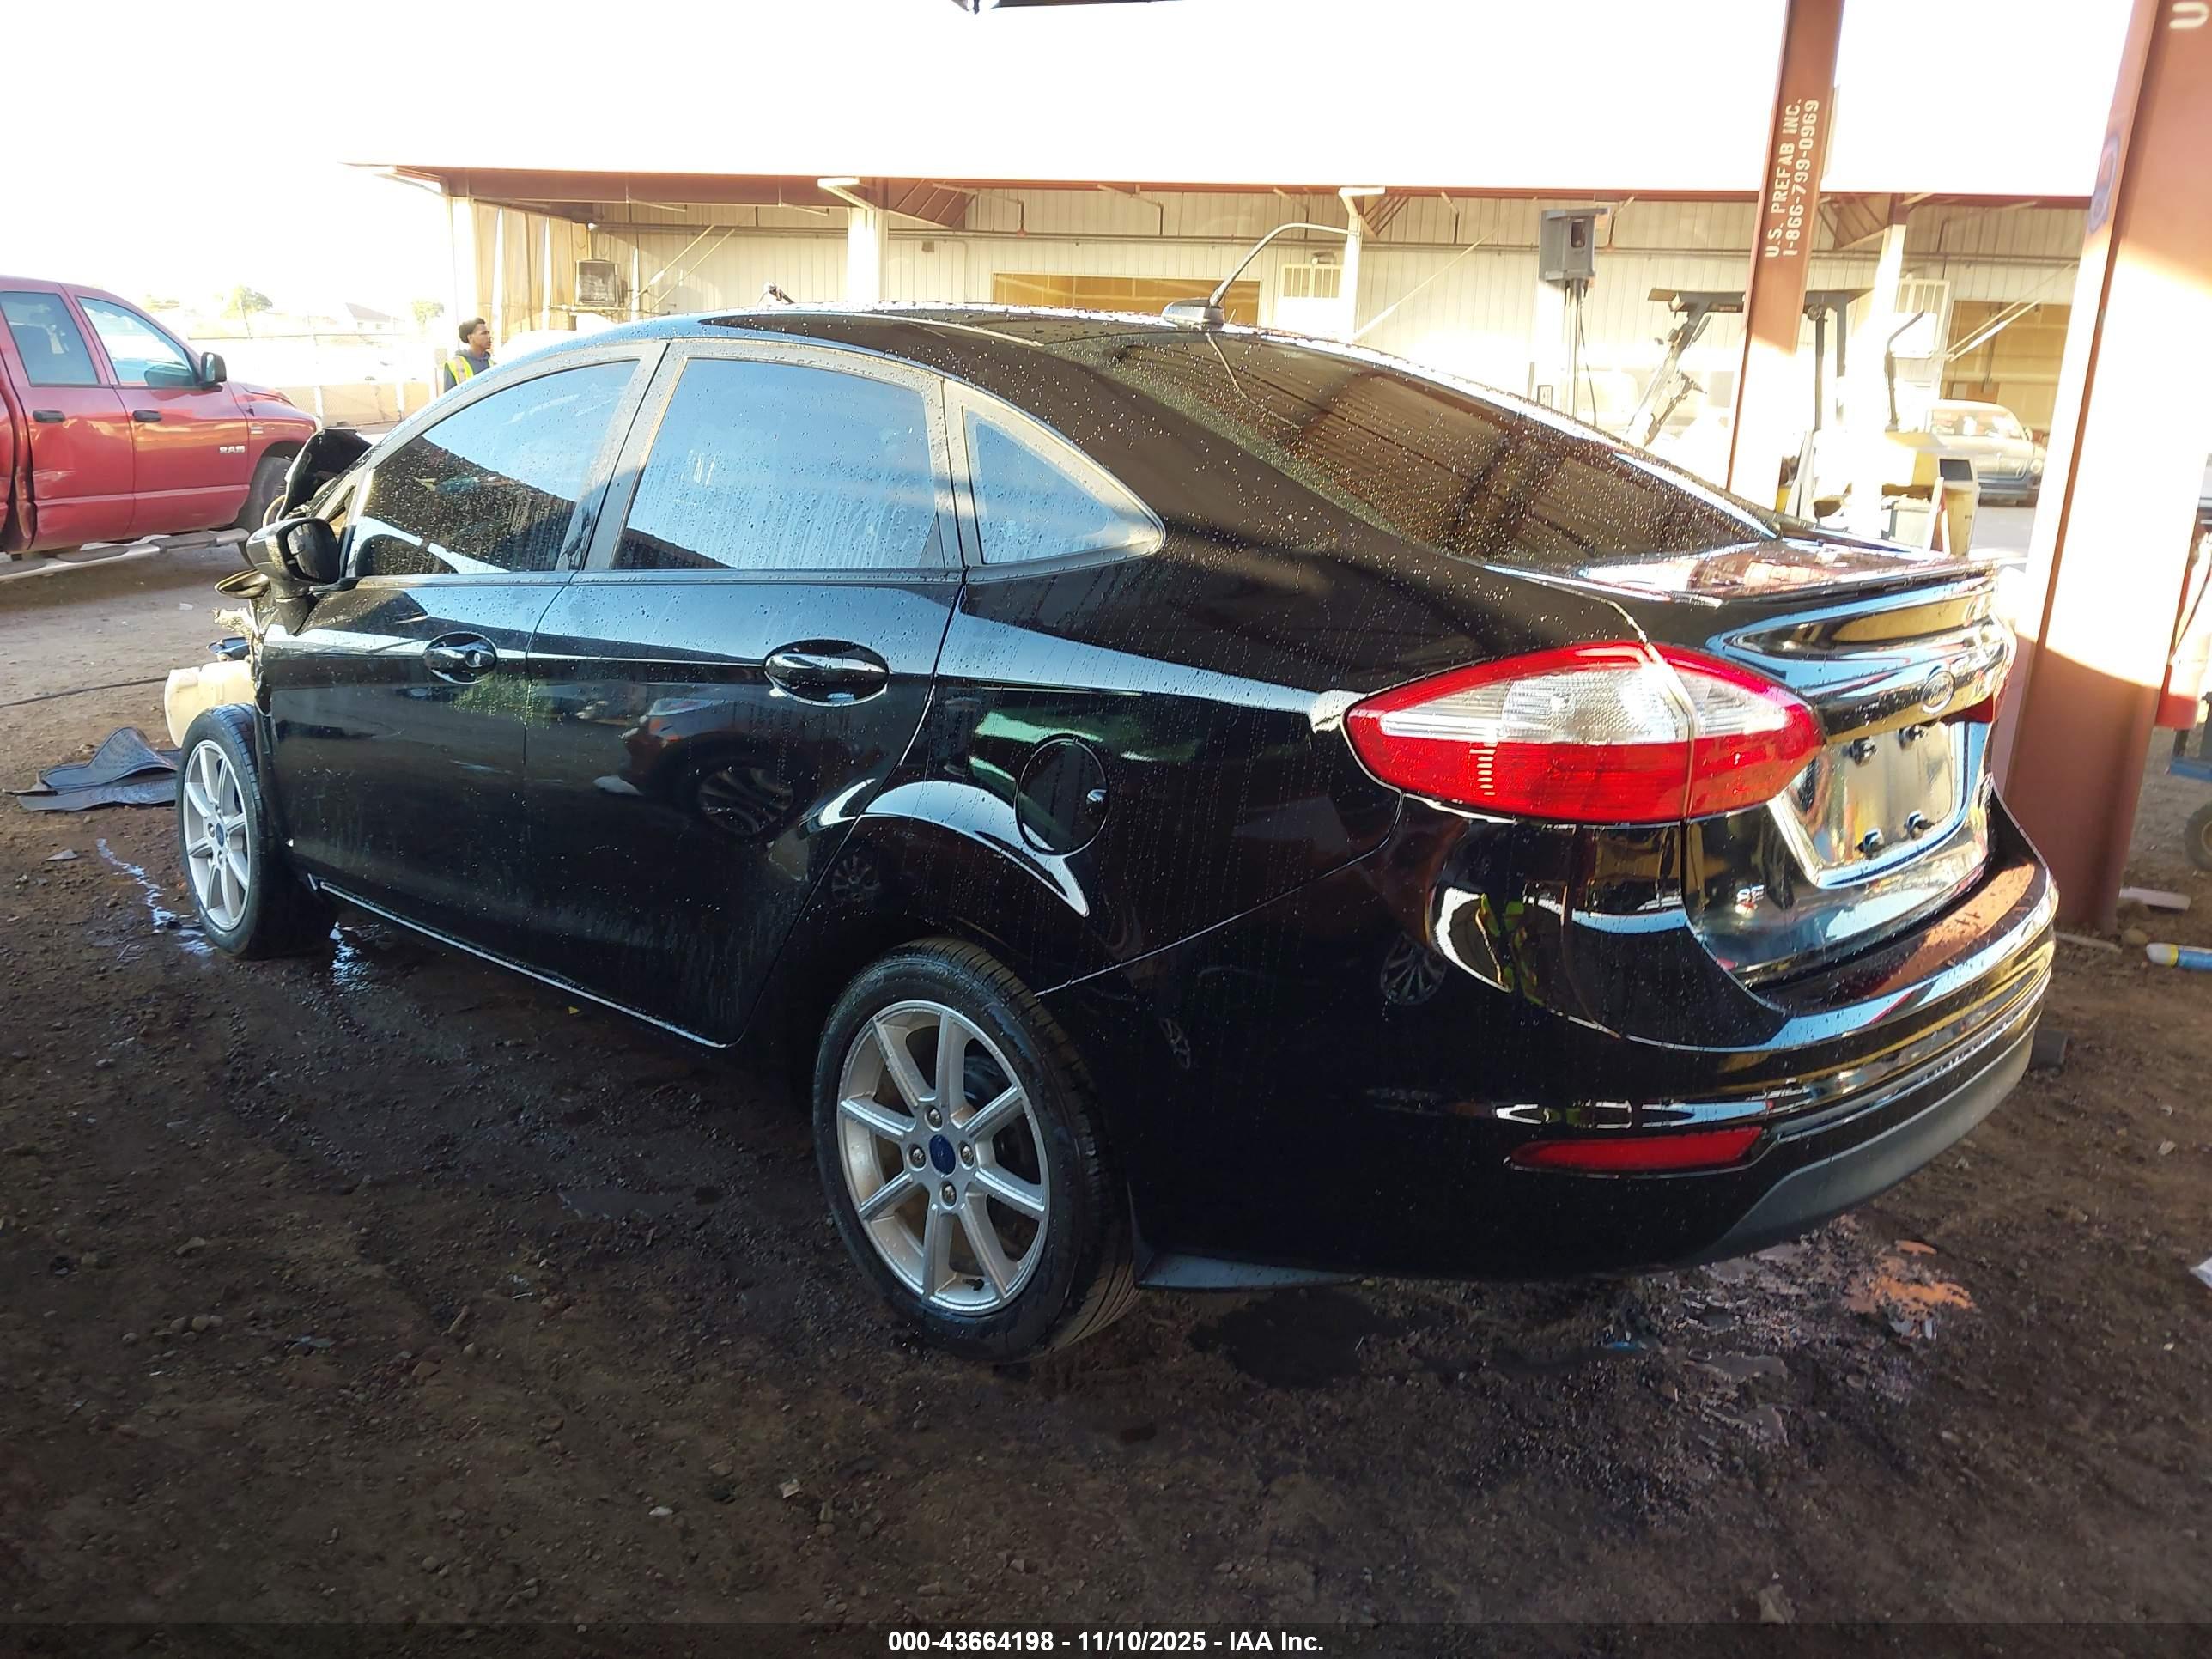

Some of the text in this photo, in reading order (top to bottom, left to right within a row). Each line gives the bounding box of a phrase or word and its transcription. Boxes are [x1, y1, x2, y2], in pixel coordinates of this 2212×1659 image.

[1765, 98, 1802, 258] U.S. PREFAB INC.
[1783, 99, 1820, 257] 1-866-799-0969
